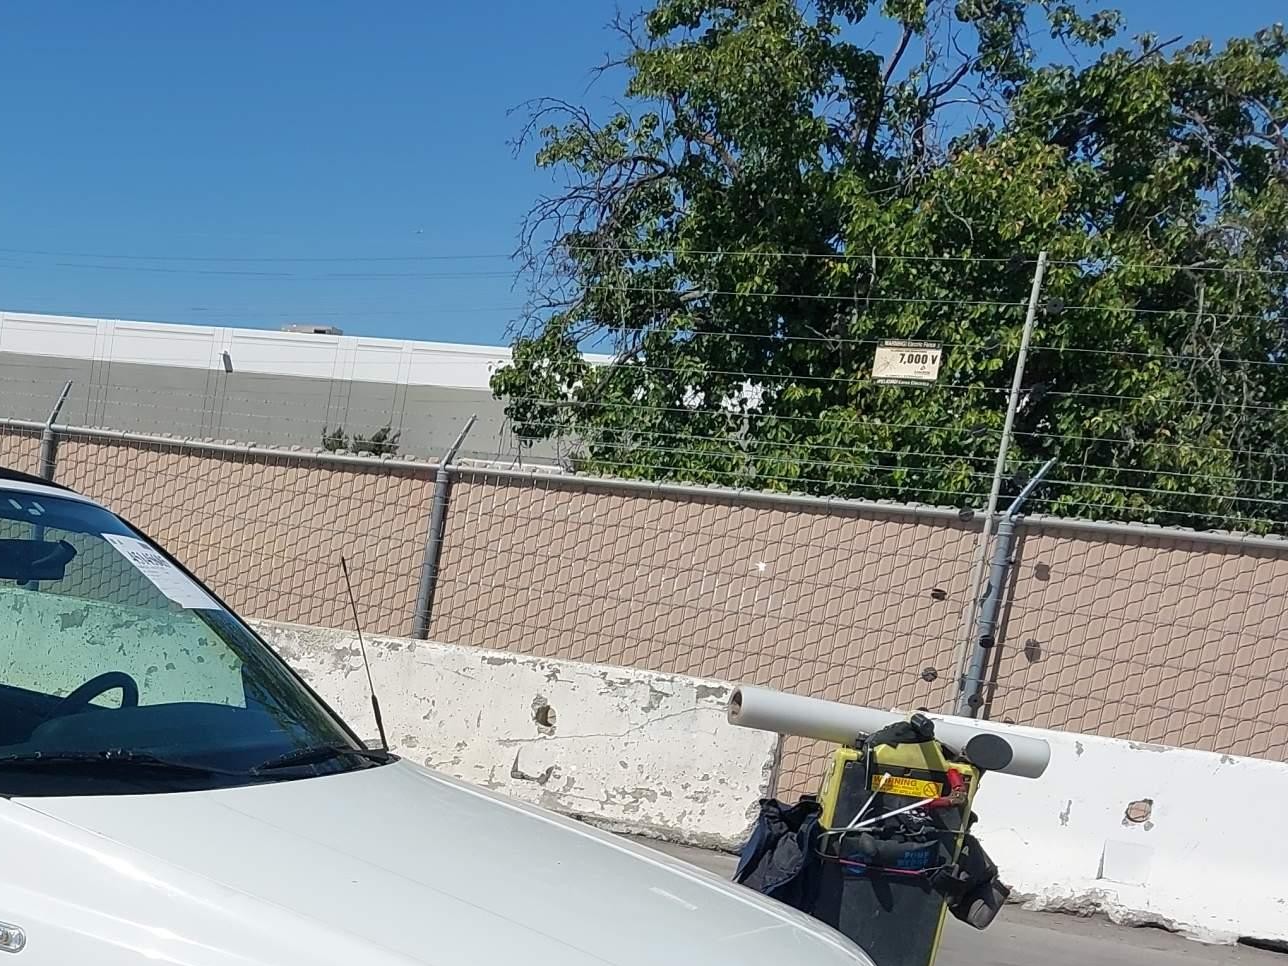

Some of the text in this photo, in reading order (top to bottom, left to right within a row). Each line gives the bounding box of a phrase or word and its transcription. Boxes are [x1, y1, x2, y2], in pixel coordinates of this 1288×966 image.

[899, 353, 938, 364] 7,000 V
[873, 776, 917, 786] WRNING
